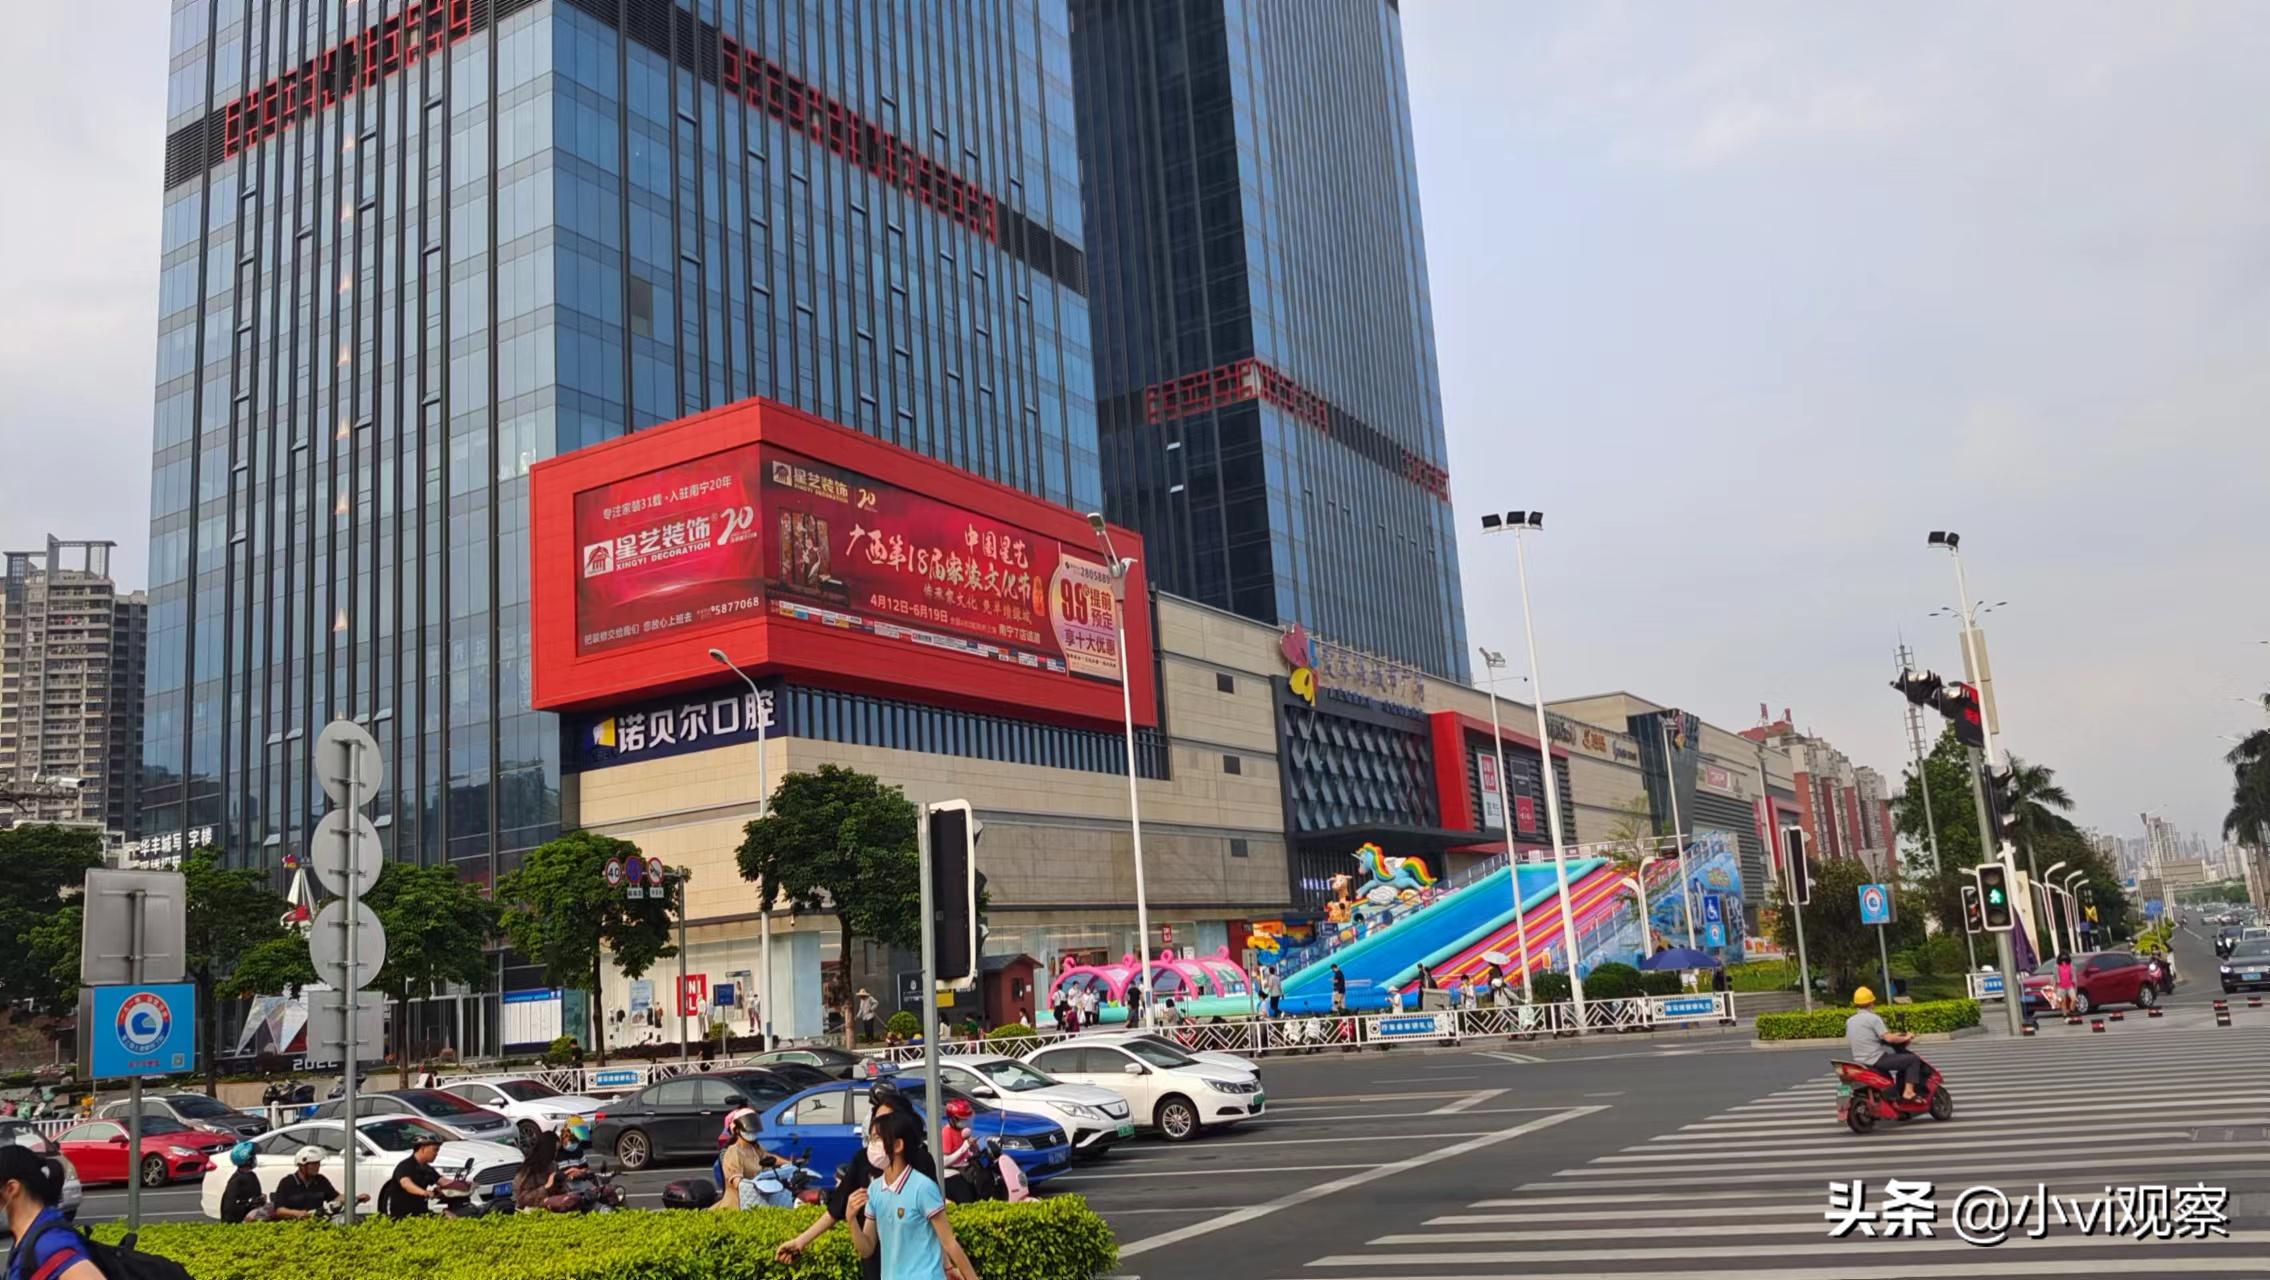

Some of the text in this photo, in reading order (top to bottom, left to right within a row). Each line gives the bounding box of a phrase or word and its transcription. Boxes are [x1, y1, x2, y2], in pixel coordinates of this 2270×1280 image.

[616, 516, 710, 560] 星艺装饰
[717, 506, 754, 546] 20
[616, 541, 711, 570] XINGYI DECORATION
[715, 596, 760, 616] 5877068
[870, 594, 949, 623] 4月12日-6月19日
[1090, 587, 1112, 611] 提前
[1091, 608, 1113, 630] 预定
[1064, 629, 1116, 656] 享十大优惠
[617, 688, 775, 754] 诺贝尔口腔
[140, 826, 213, 857] 华丰城写字楼
[608, 867, 620, 878] 40
